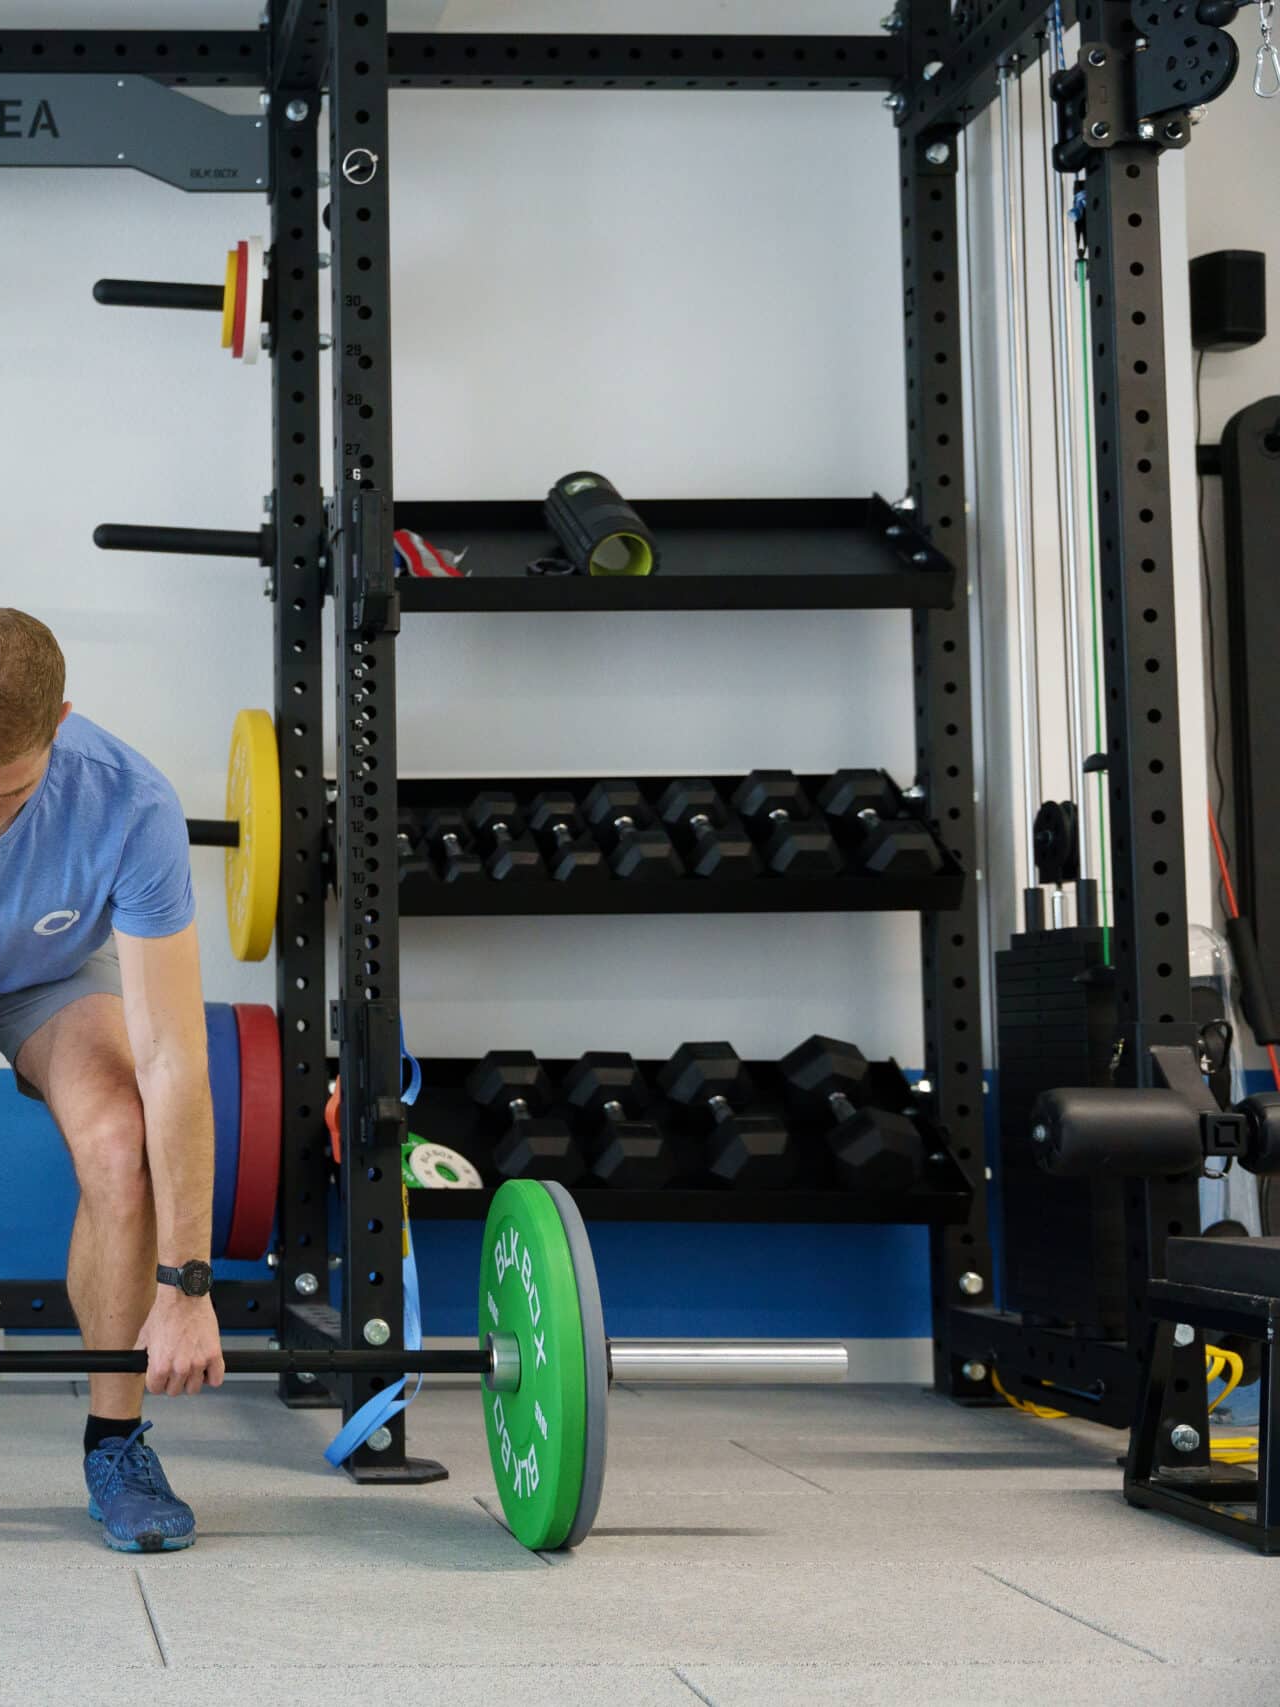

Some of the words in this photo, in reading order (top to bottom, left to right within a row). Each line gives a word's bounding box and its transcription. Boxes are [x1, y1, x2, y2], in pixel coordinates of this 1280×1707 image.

[345, 468, 361, 480] 26
[494, 1226, 520, 1284] BLK
[521, 1245, 547, 1369] BOX
[493, 1394, 512, 1473] BO
[512, 1443, 540, 1499] BLK
